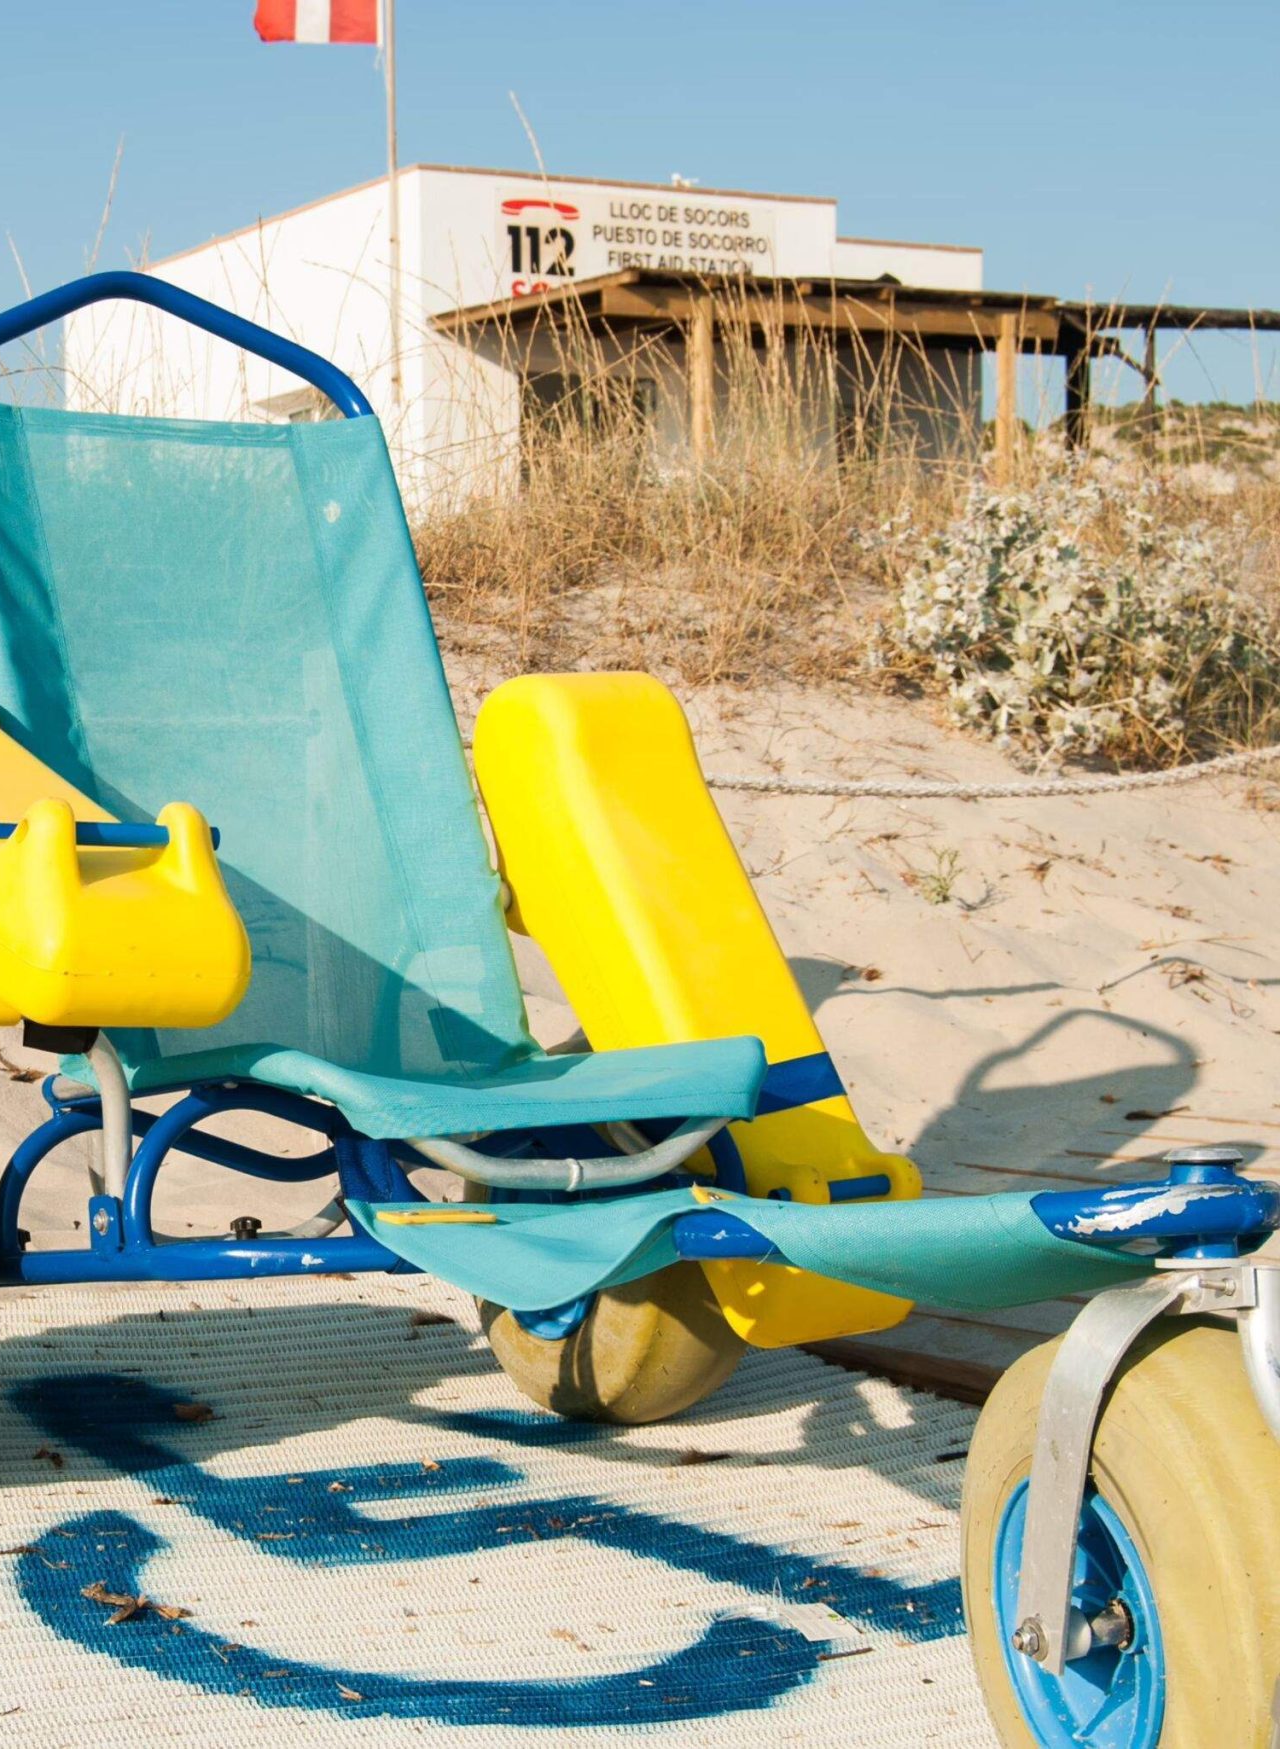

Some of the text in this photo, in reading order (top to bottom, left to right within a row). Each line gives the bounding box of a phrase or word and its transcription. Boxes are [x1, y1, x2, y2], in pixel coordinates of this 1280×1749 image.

[609, 202, 750, 229] LLOC DE SOCORS
[507, 225, 574, 276] 112
[593, 224, 768, 254] PUESTO DE SOCORRO
[608, 250, 652, 268] FIRST
[658, 254, 683, 271] AID
